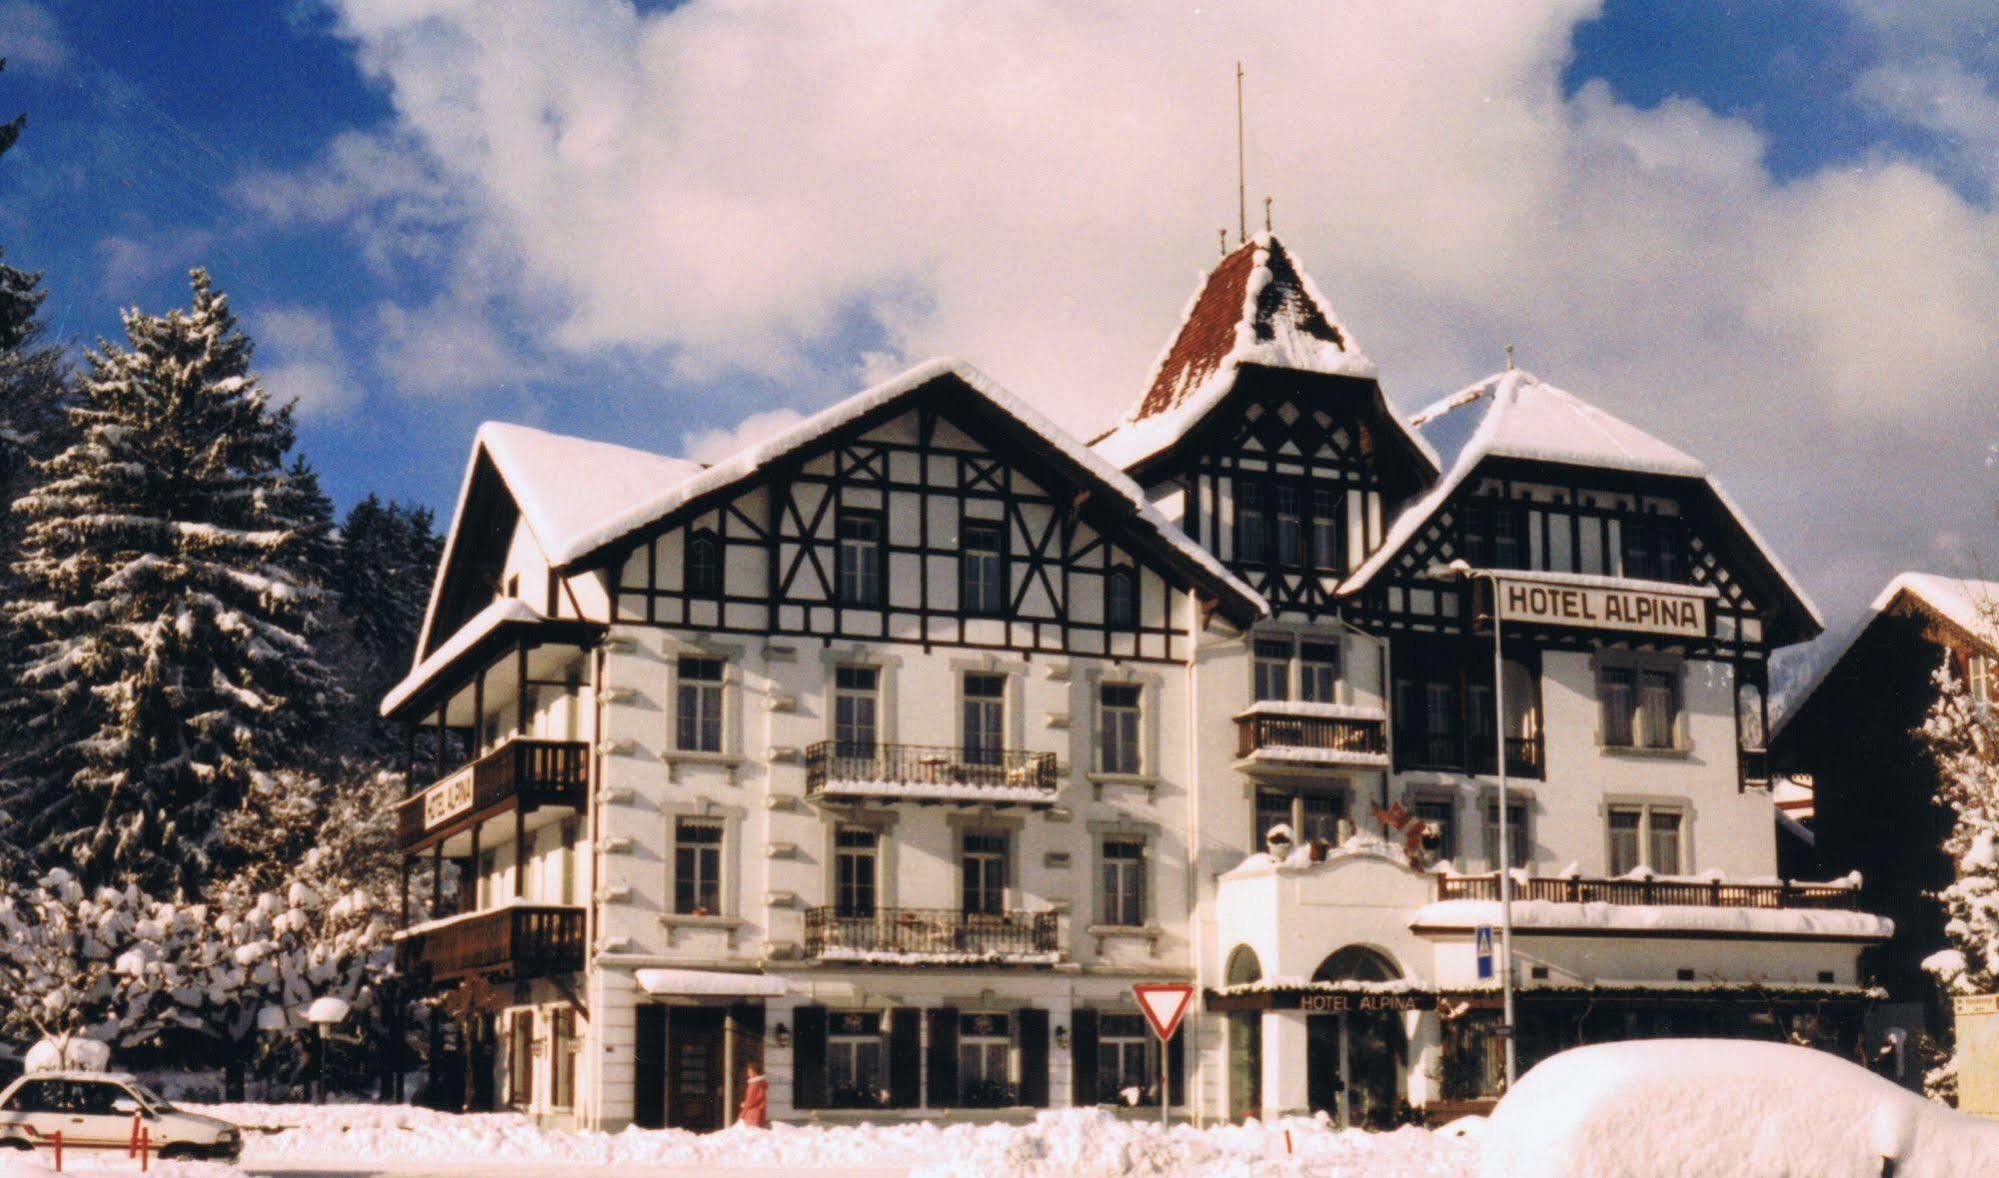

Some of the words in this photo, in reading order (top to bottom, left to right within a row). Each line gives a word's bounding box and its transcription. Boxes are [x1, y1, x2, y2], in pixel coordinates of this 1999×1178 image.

[1508, 586, 1597, 620] HOTEL
[1605, 594, 1699, 629] ALPINA
[1301, 996, 1351, 1010] HOTEL
[1360, 996, 1416, 1010] ALPINA
